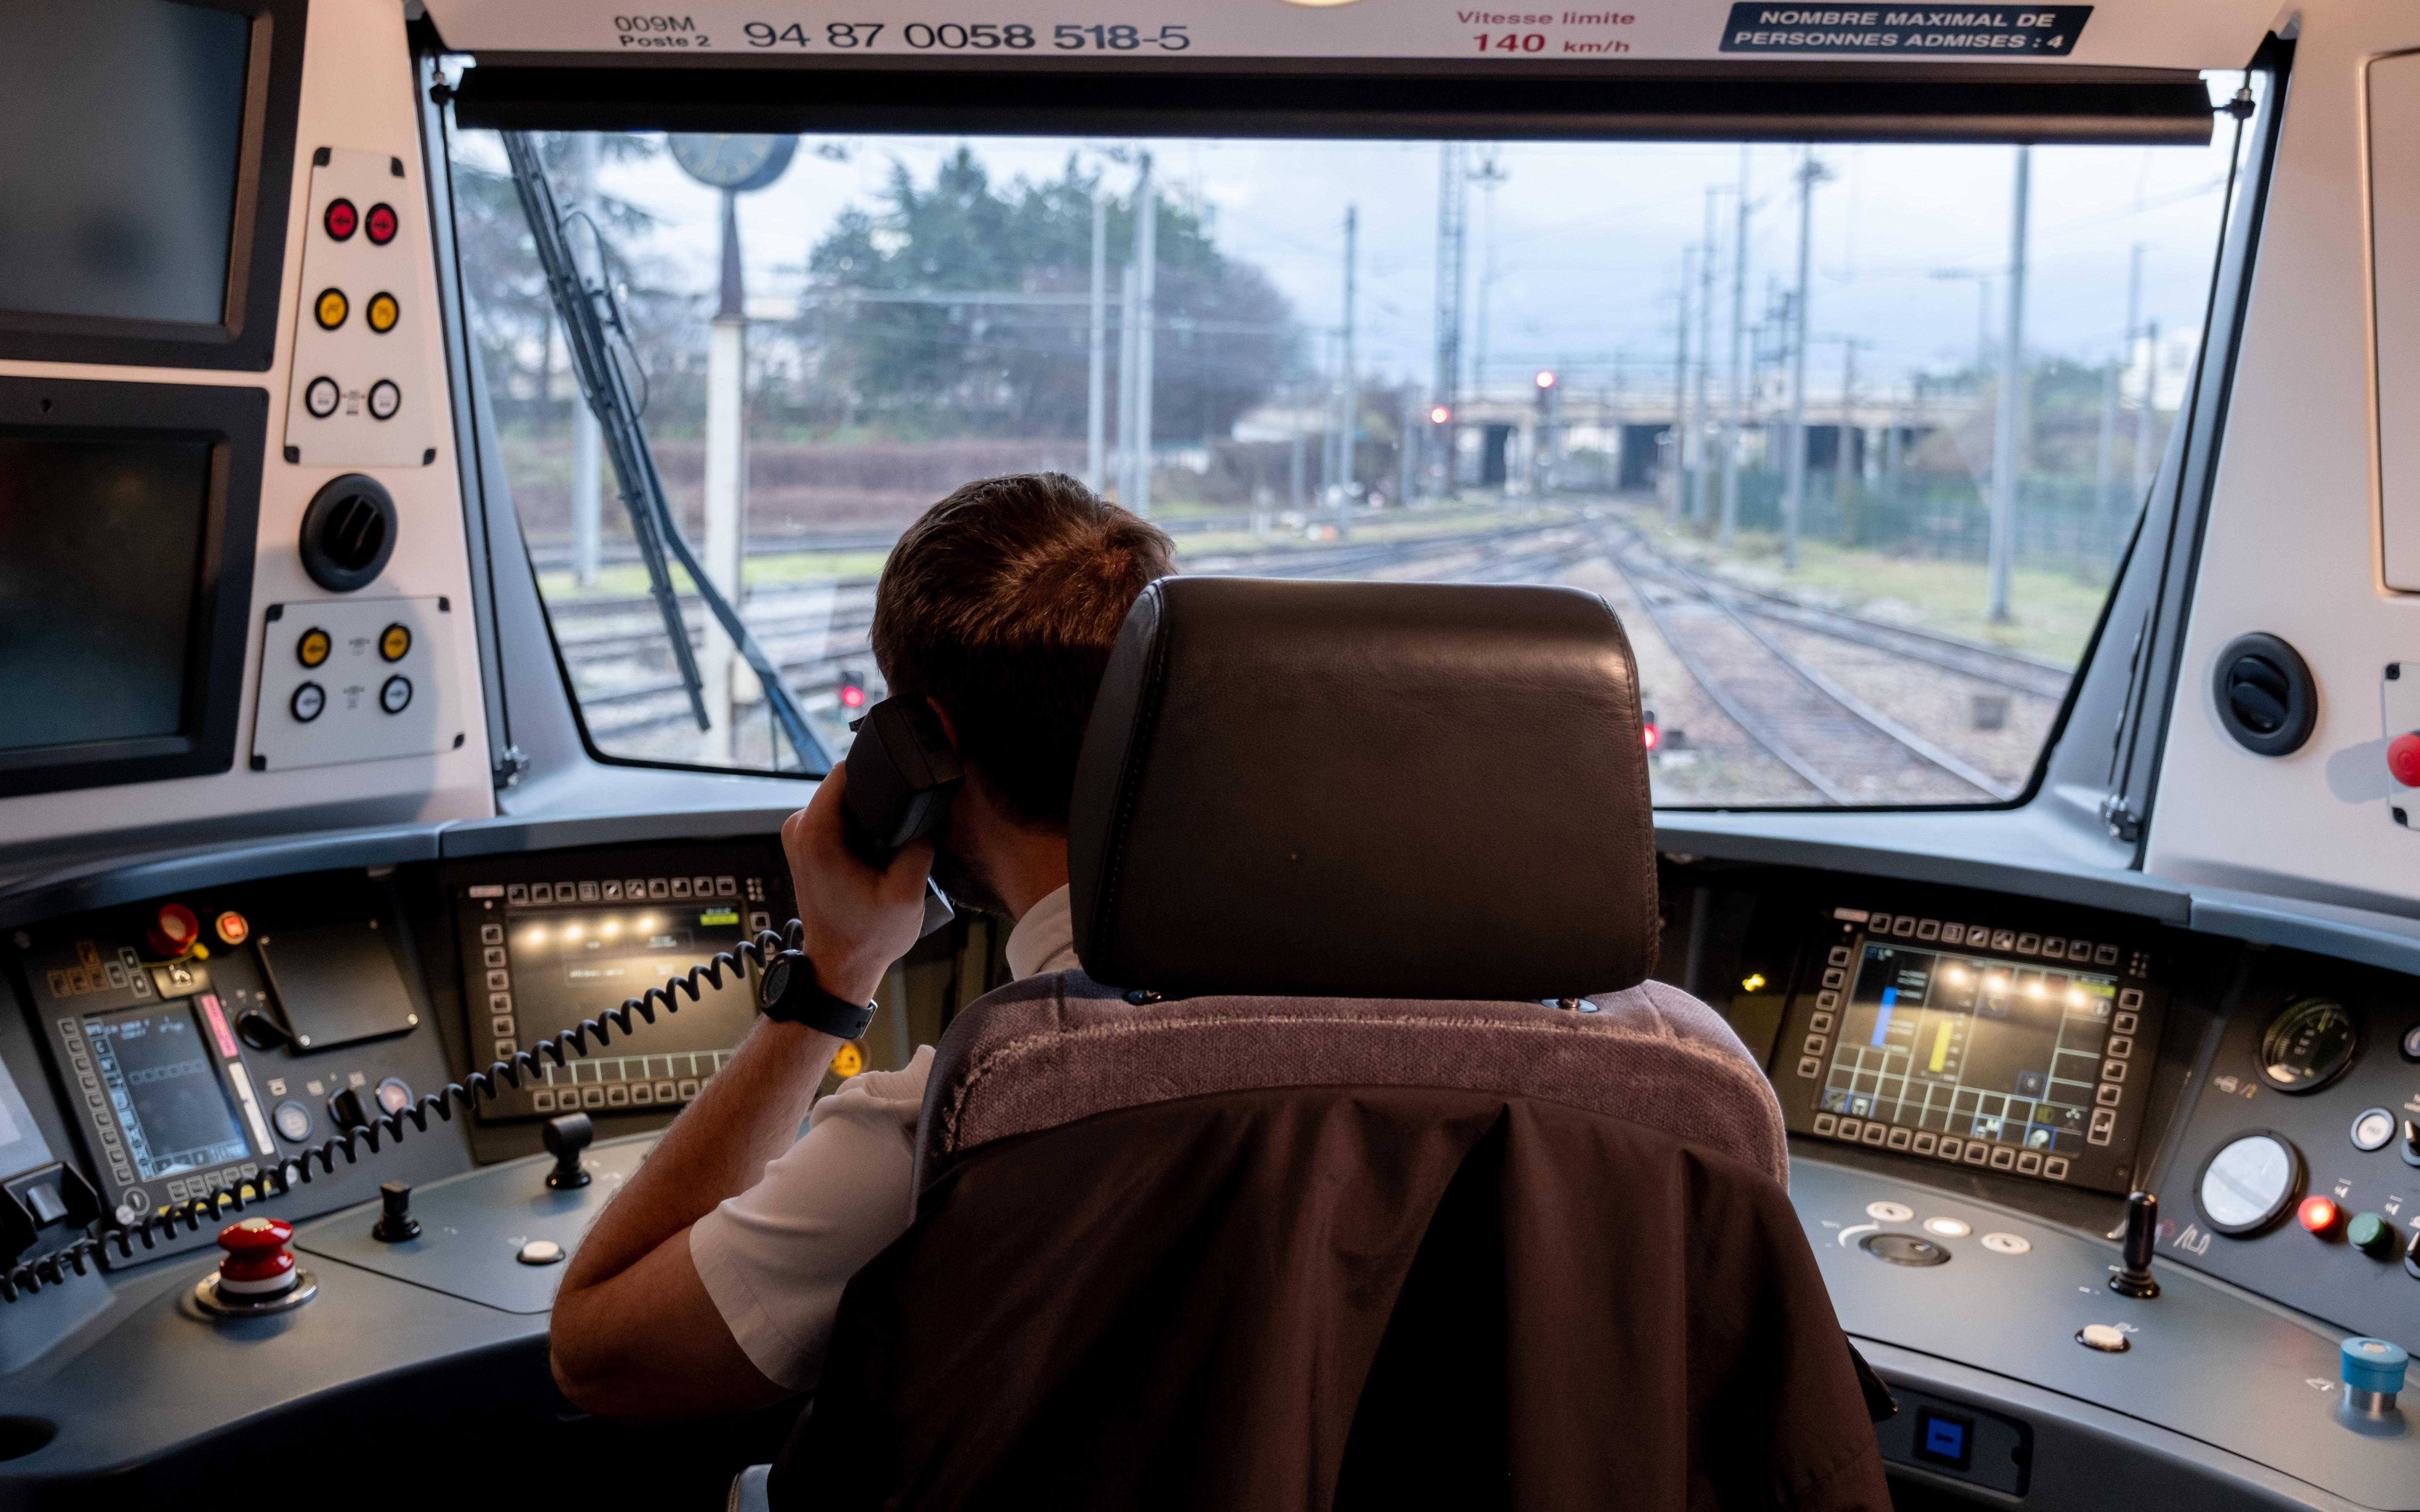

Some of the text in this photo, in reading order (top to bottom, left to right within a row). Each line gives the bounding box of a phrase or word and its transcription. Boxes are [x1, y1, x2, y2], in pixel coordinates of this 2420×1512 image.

[614, 16, 695, 32] 009M
[1457, 11, 1636, 25] Vitesse limite
[1759, 10, 2057, 27] NOMBRE MAXIMAL DE
[619, 35, 711, 47] Poste 2
[744, 22, 1190, 50] 94 87 0058 518-5
[1473, 33, 1630, 53] 140 km/h
[1734, 31, 1899, 47] PERSONNES
[1903, 34, 2027, 48] ADMISES
[2046, 35, 2063, 48] 4
